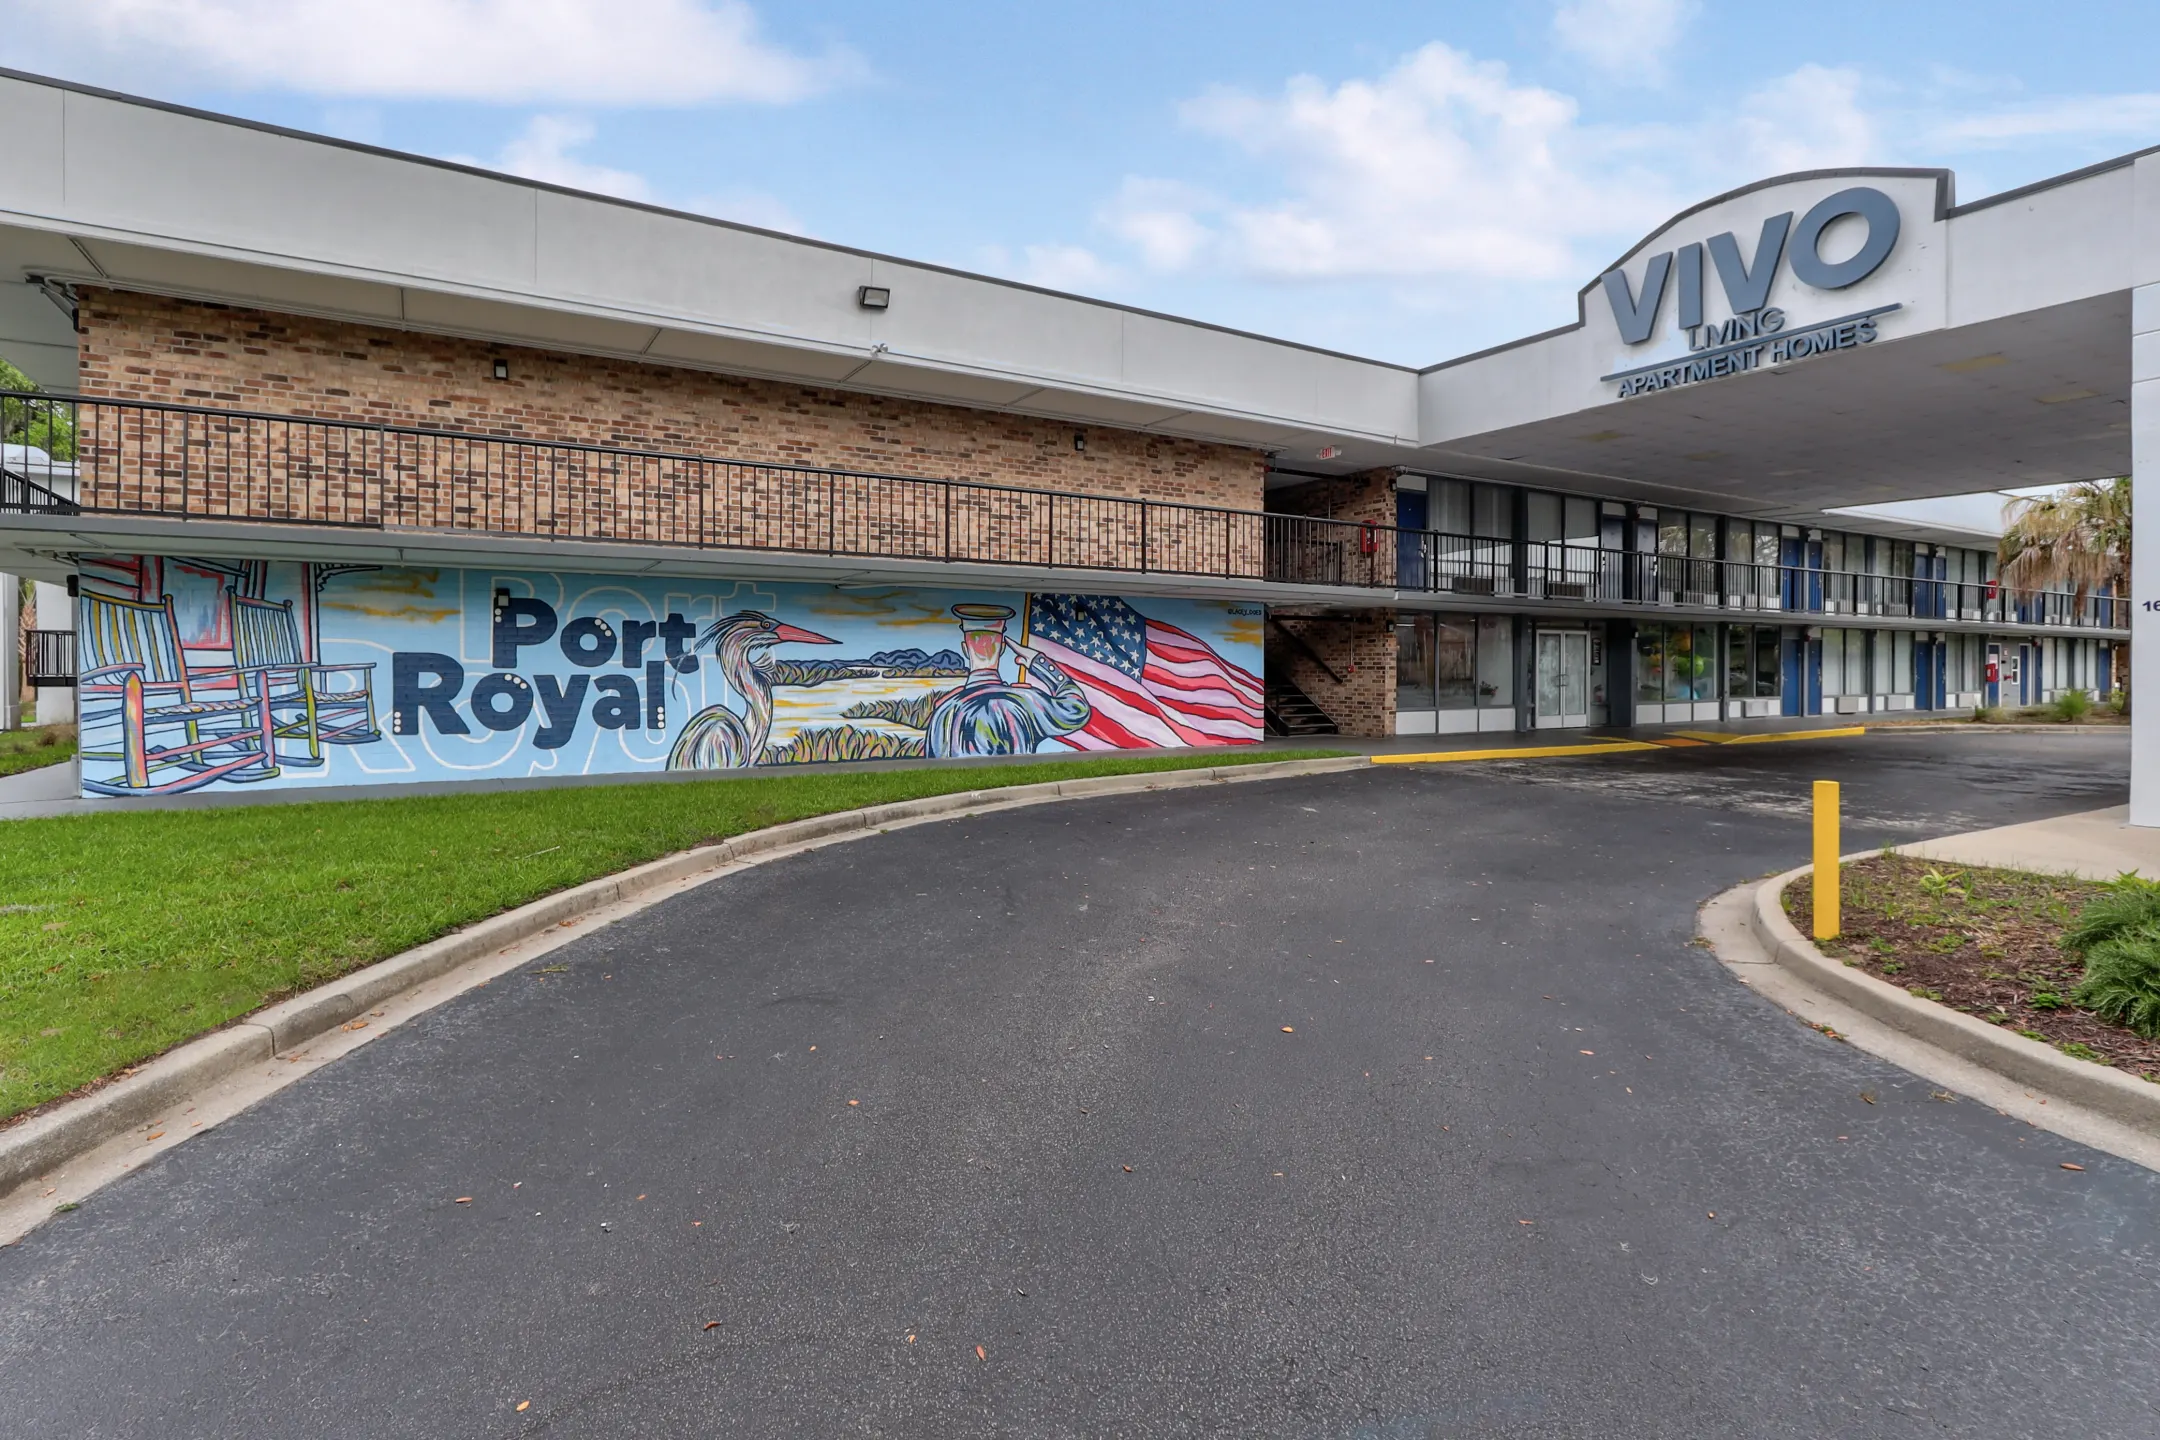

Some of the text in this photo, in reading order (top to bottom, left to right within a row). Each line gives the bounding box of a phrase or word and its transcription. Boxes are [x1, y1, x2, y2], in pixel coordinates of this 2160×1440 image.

[1601, 186, 1900, 345] VIVO
[1617, 318, 1878, 398] APARTMENT HOMES
[1688, 307, 1785, 352] LIVING
[492, 596, 700, 675] Port
[392, 651, 665, 750] Royal
